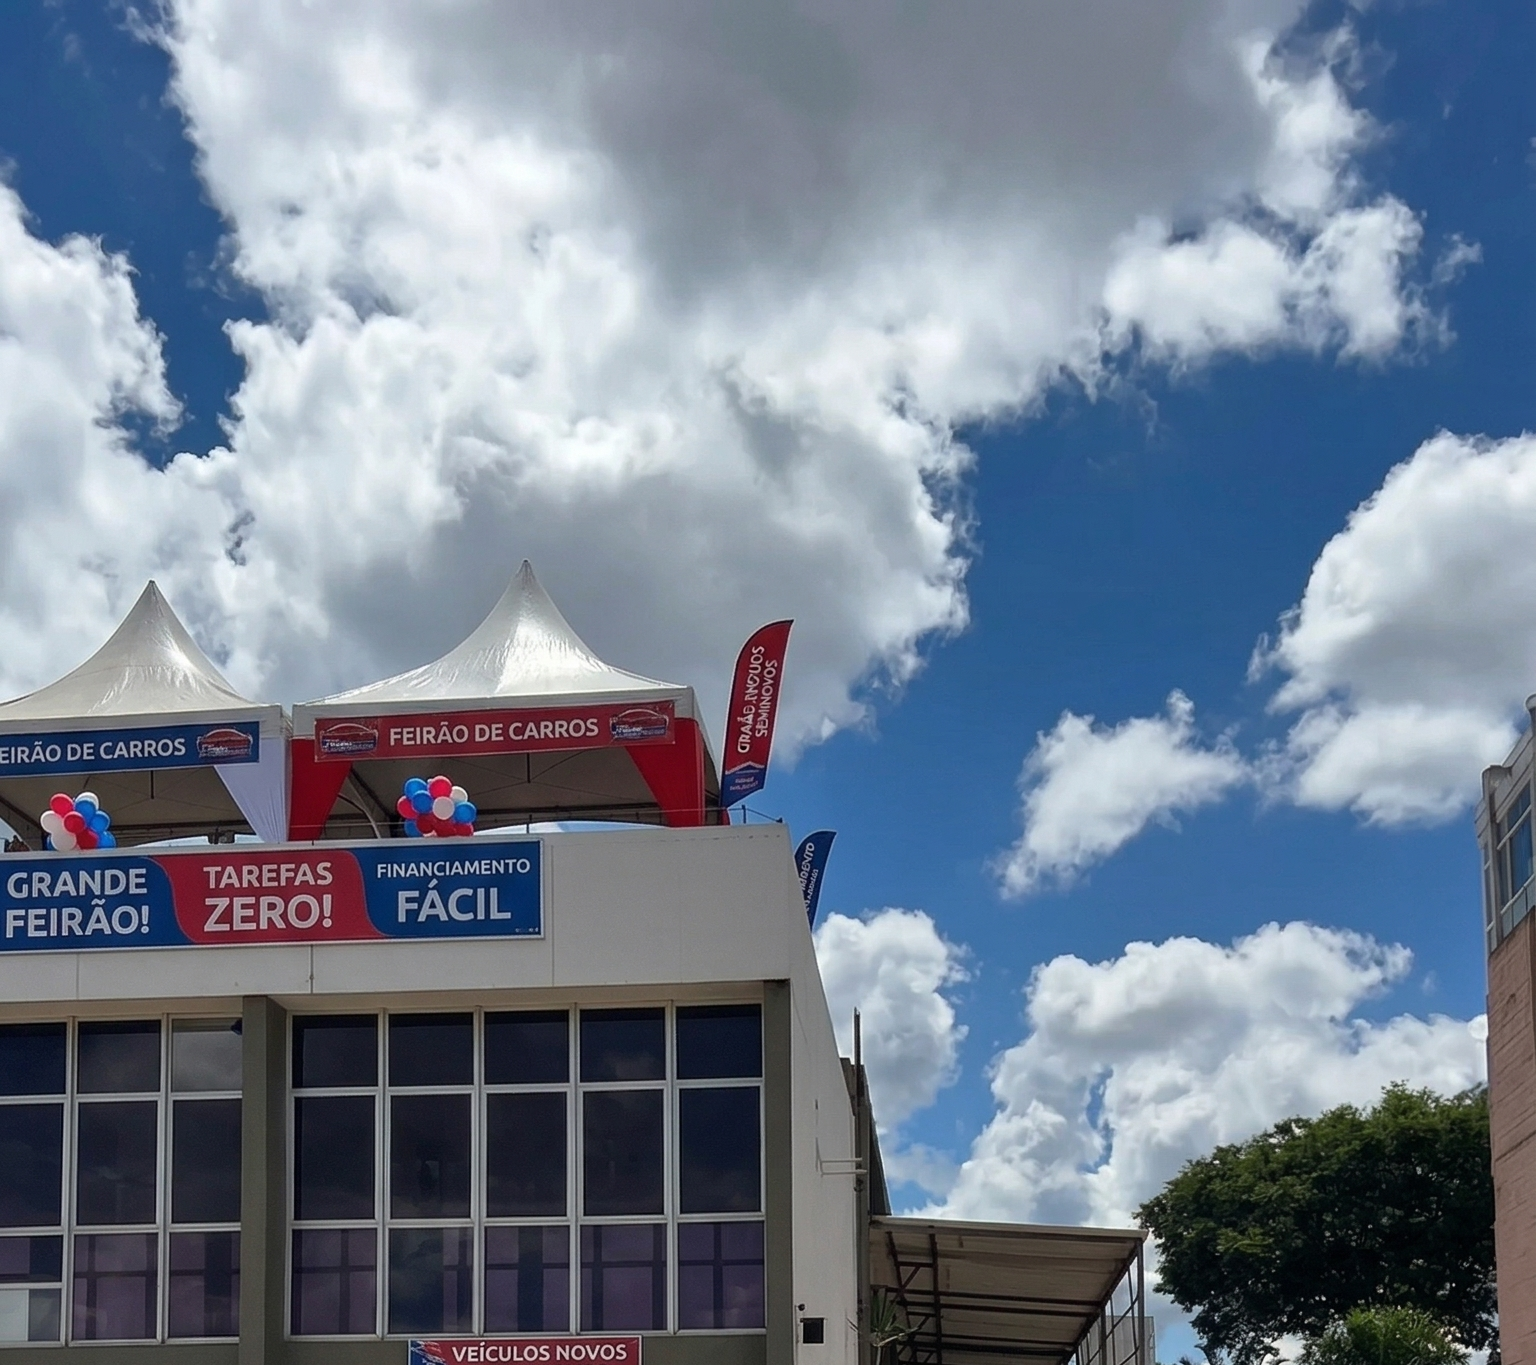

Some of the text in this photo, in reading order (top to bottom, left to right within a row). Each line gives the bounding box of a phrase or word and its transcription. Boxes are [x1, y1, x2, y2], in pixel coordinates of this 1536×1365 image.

[389, 720, 469, 747] FEIRÃO
[475, 722, 504, 743] DE
[508, 717, 600, 741] CARROS
[0, 741, 62, 765] EIRÃO
[66, 742, 95, 762] DE
[100, 738, 187, 761] CARROS
[203, 862, 334, 890] TAREFAS
[377, 857, 531, 879] FINANCIAMENTO
[6, 868, 148, 900] GRANDE
[203, 893, 333, 933] ZERO!
[397, 879, 512, 924] FÁCIL
[5, 898, 150, 939] FEIRÃO!
[451, 1341, 628, 1363] VEÍCULOS NOVOS
